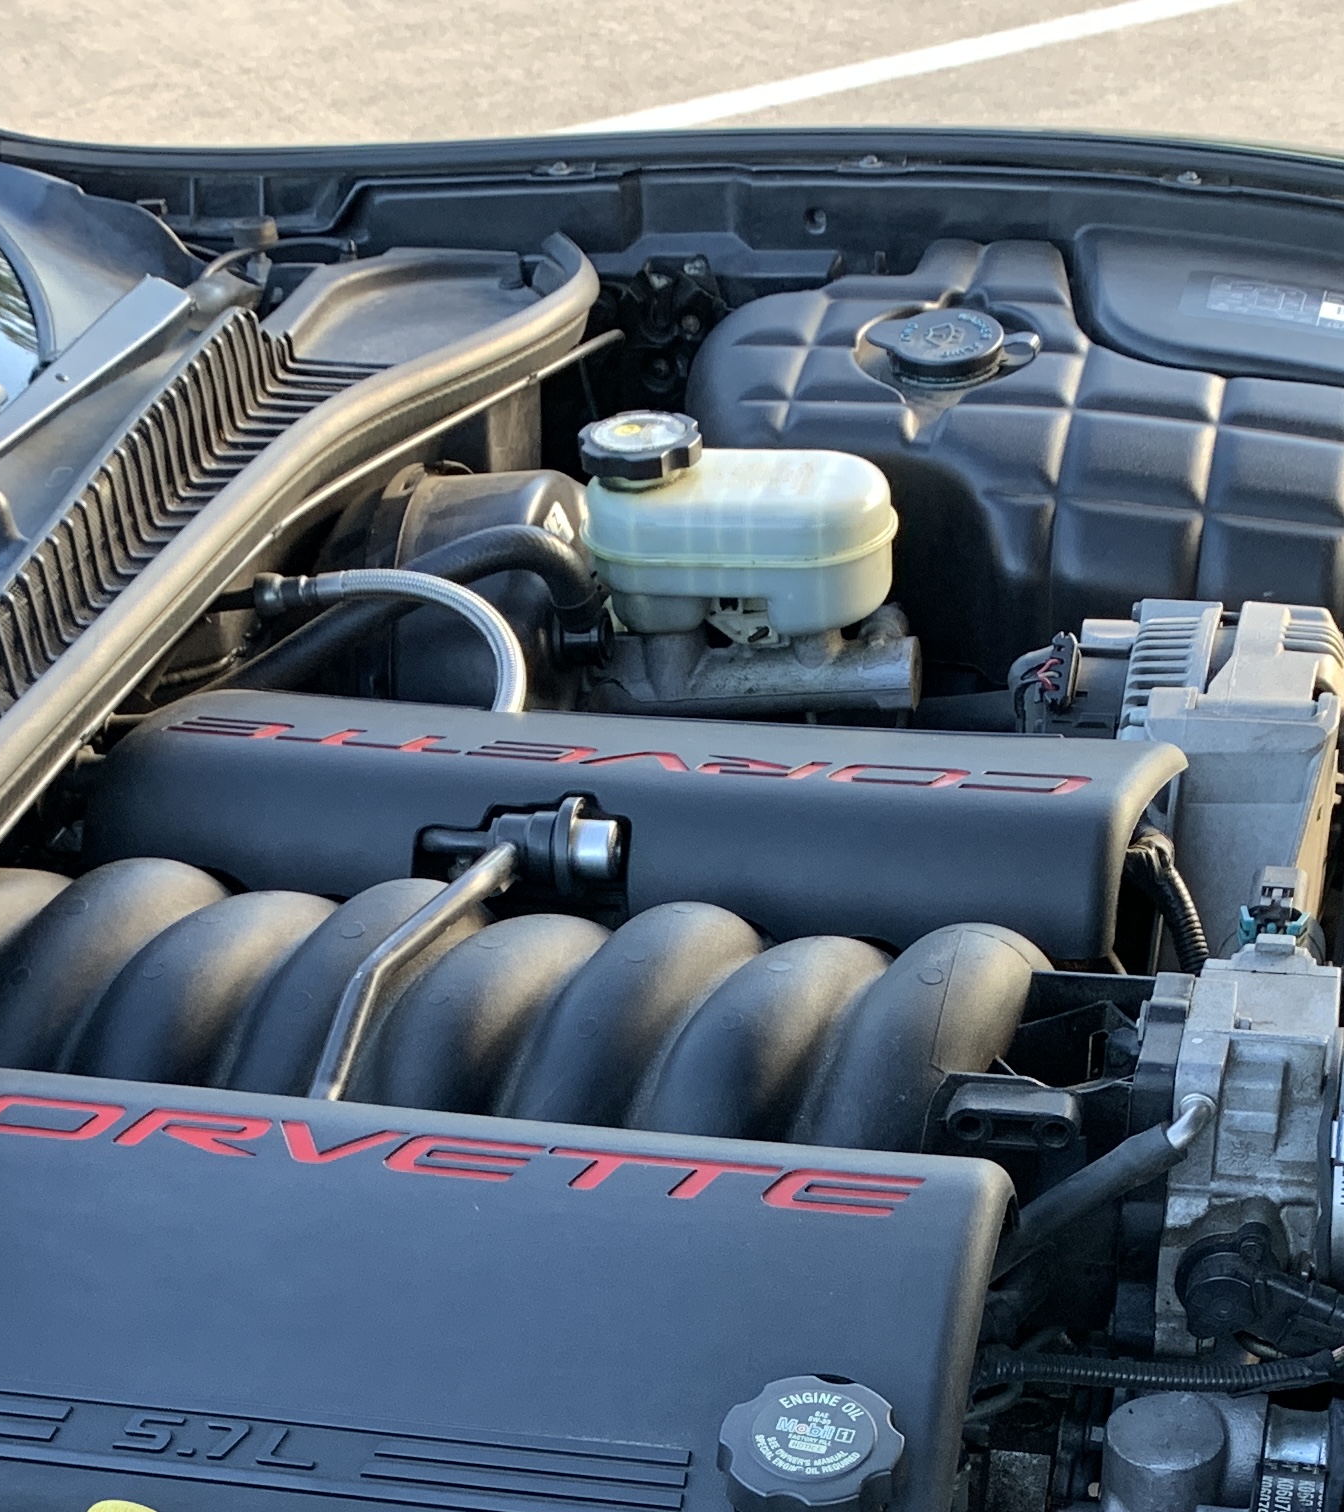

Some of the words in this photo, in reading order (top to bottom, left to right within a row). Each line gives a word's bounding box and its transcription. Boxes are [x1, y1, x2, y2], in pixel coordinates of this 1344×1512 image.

[165, 715, 1093, 797] CORVETTE
[779, 1392, 841, 1409] ENGINE
[841, 1402, 865, 1422] OIL
[111, 1408, 318, 1472] 5.7L
[776, 1416, 836, 1440] Mobil
[788, 1433, 818, 1444] FACTORY
[754, 1434, 775, 1461] SPECIAL
[805, 1466, 820, 1475] OIL
[821, 1451, 861, 1474] REQUIRED
[767, 1436, 781, 1451] SEE
[775, 1448, 811, 1467] OWNER'S
[813, 1450, 849, 1466] MANUAL
[791, 1440, 822, 1452] NOTICE
